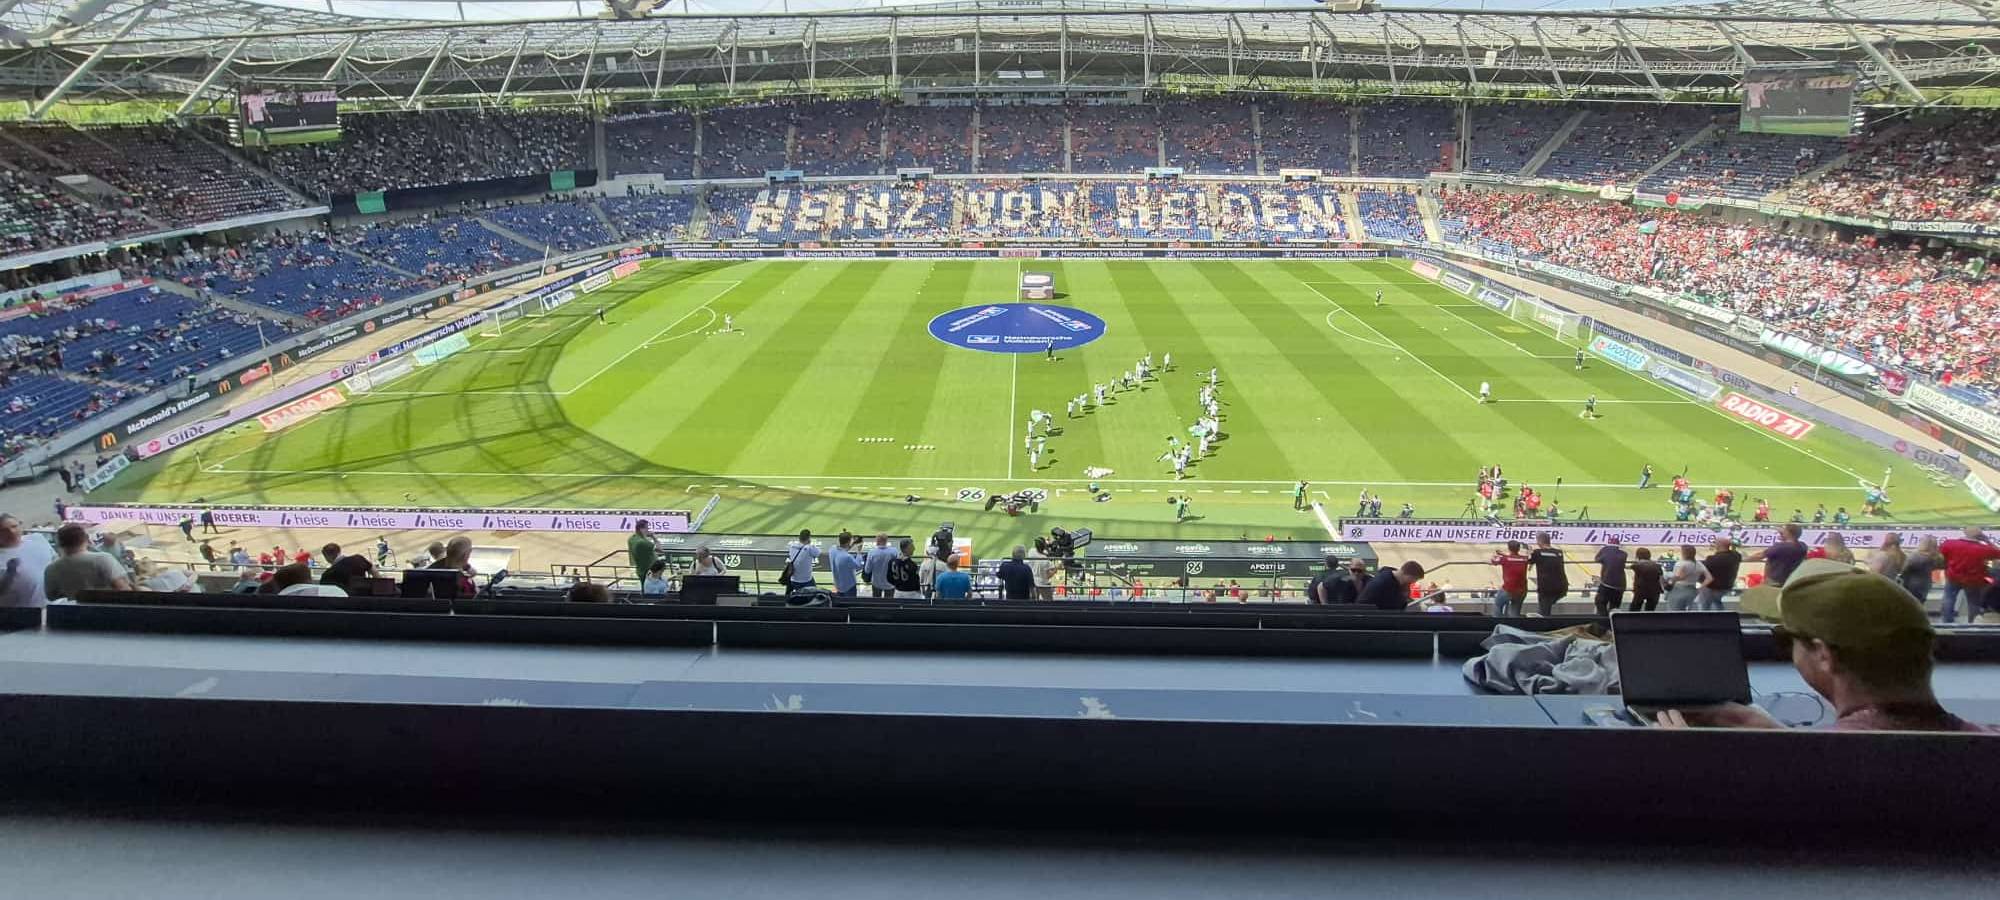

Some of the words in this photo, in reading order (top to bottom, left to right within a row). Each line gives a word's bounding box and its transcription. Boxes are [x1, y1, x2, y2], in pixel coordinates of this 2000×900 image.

[746, 190, 930, 232] HEINZ
[968, 191, 1074, 229] VON
[1116, 186, 1342, 232] HEIDEN
[402, 324, 455, 350] Hannoversche
[454, 310, 488, 330] Volksbank
[127, 405, 178, 435] McDonald's
[177, 391, 210, 411] Ehmann
[1722, 395, 1777, 426] RADIO
[1775, 414, 1804, 436] 21
[167, 423, 205, 446] Gilde
[959, 489, 983, 499] 96
[100, 511, 133, 520] DANKE
[139, 511, 152, 521] AN
[157, 512, 197, 522] UNSEE
[206, 513, 261, 523] RDERER:
[294, 513, 329, 526] heise
[361, 514, 396, 527] heise
[429, 515, 464, 528] heise
[497, 516, 532, 529] heise
[566, 517, 601, 530] heise
[1384, 528, 1422, 538] DANKE
[1426, 528, 1442, 538] AN
[1447, 529, 1491, 539] UNSERE
[1496, 527, 1564, 540] FÖRDER:
[1677, 530, 1717, 544] heise
[1754, 531, 1780, 544] hei
[726, 554, 740, 566] 96
[891, 560, 909, 581] 96
[1187, 561, 1202, 573] 96
